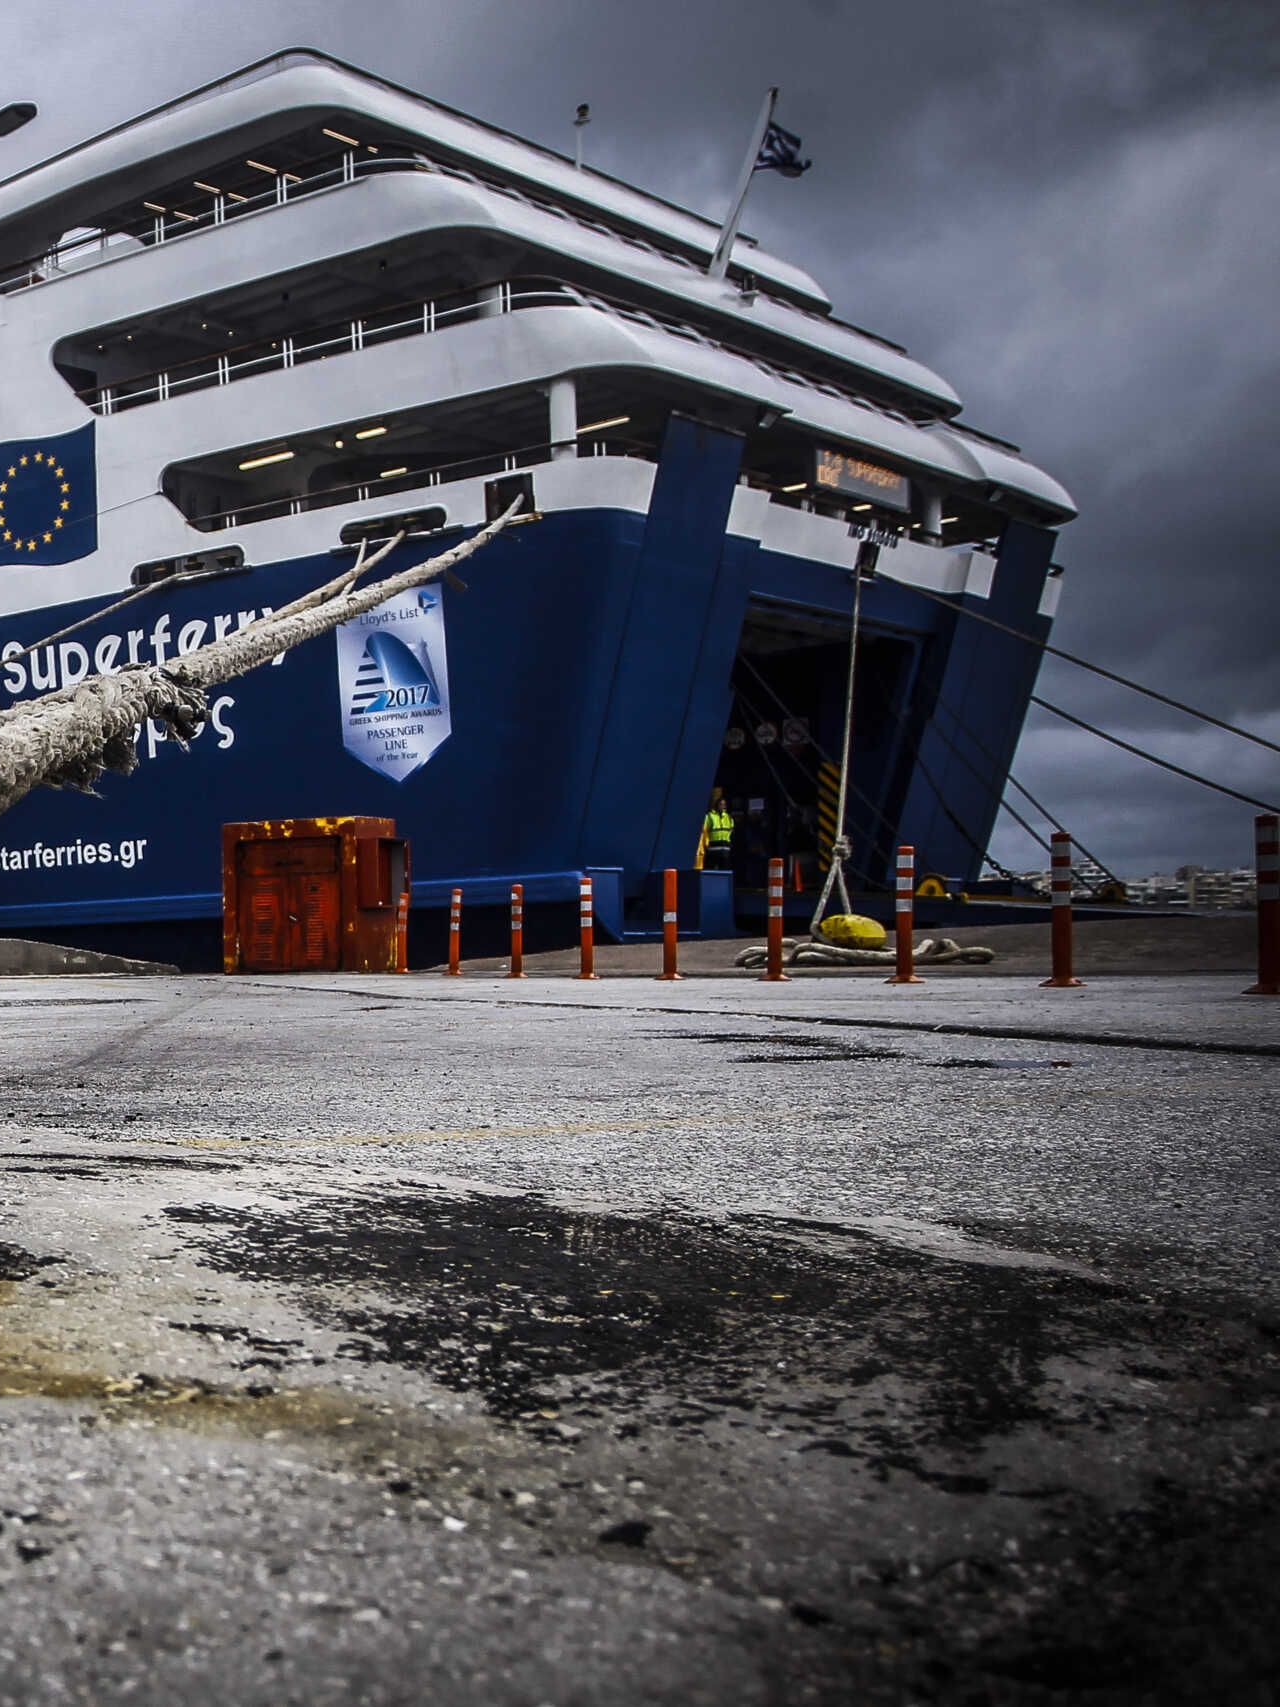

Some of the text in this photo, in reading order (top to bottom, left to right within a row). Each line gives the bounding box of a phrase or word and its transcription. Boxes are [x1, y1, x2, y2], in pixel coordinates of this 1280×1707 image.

[359, 607, 418, 626] Lloyd's List
[385, 685, 430, 709] 2017
[349, 708, 443, 726] GREEK SHIPPING AWARDS
[367, 724, 425, 739] PASSENGER
[385, 739, 409, 751] LINE
[376, 751, 418, 761] of the Year
